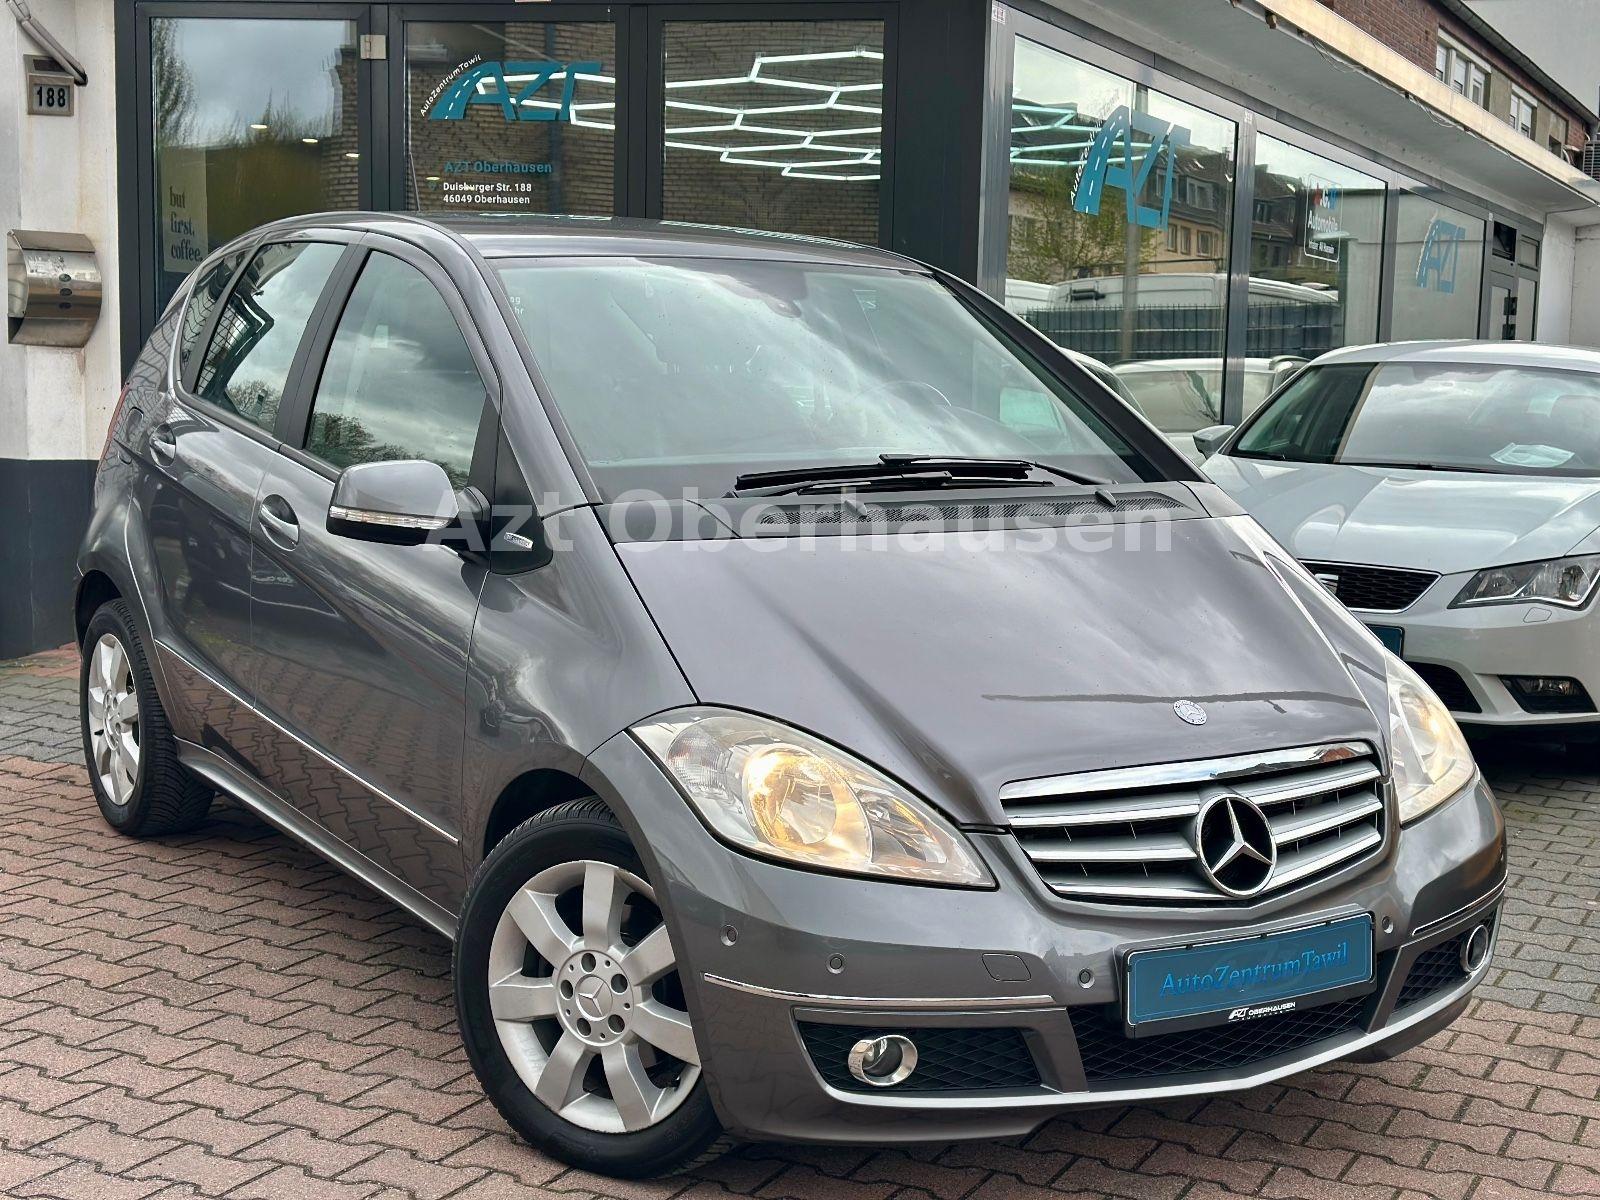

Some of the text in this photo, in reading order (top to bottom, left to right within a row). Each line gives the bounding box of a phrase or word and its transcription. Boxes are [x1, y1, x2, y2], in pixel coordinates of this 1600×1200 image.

[420, 54, 482, 117] AutoZentrumTawil
[428, 60, 602, 121] AZT
[36, 86, 66, 108] 188
[444, 160, 553, 174] AZT Oberhausen
[1073, 104, 1192, 232] AZT
[169, 186, 186, 208] but
[443, 182, 532, 193] Duisburger Str. 188
[443, 194, 530, 204] 46049 Oberhausen
[171, 238, 204, 262] coffee.
[1159, 942, 1349, 996] AutoZentrumTawil
[1228, 1001, 1296, 1019] AZT OBERHAUSEN
